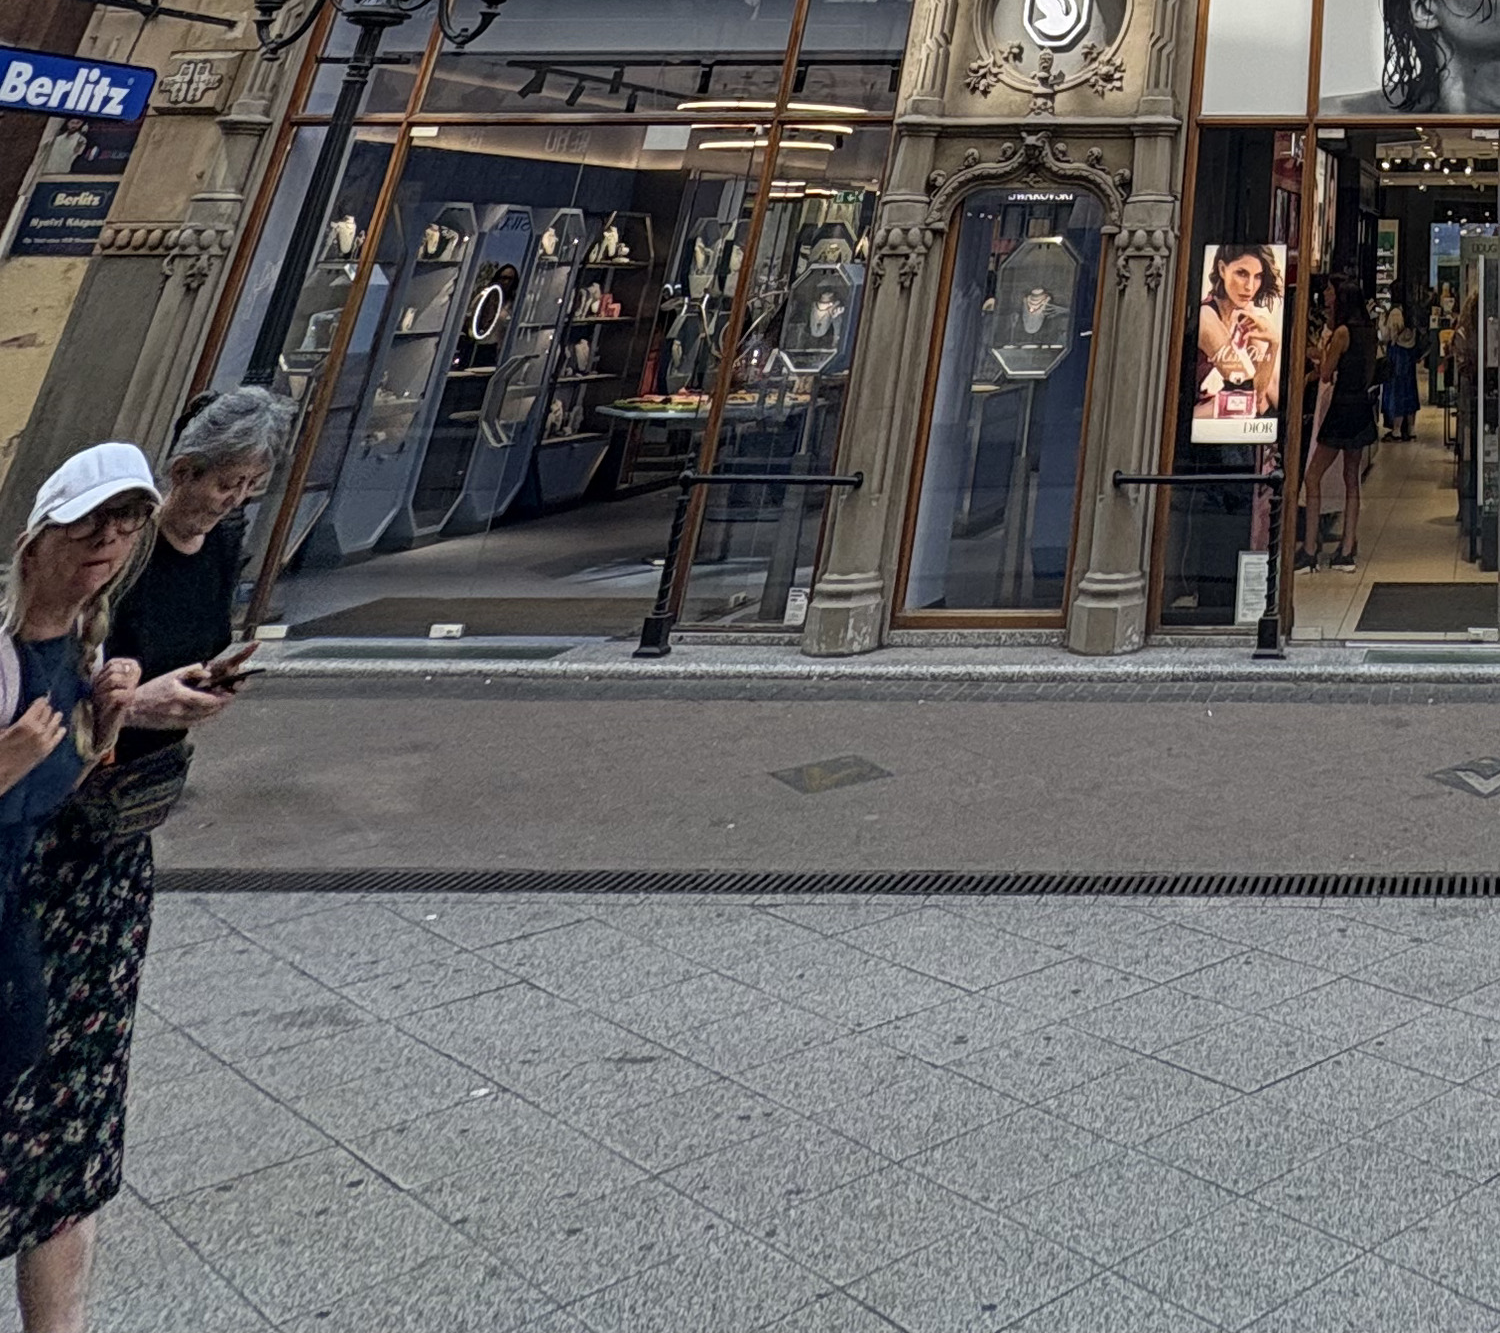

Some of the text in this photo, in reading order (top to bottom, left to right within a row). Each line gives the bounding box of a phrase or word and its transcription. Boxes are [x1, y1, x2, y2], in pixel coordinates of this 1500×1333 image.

[1, 60, 130, 116] Berlitz
[53, 192, 101, 206] Berlitz
[1243, 421, 1274, 434] DIOR
